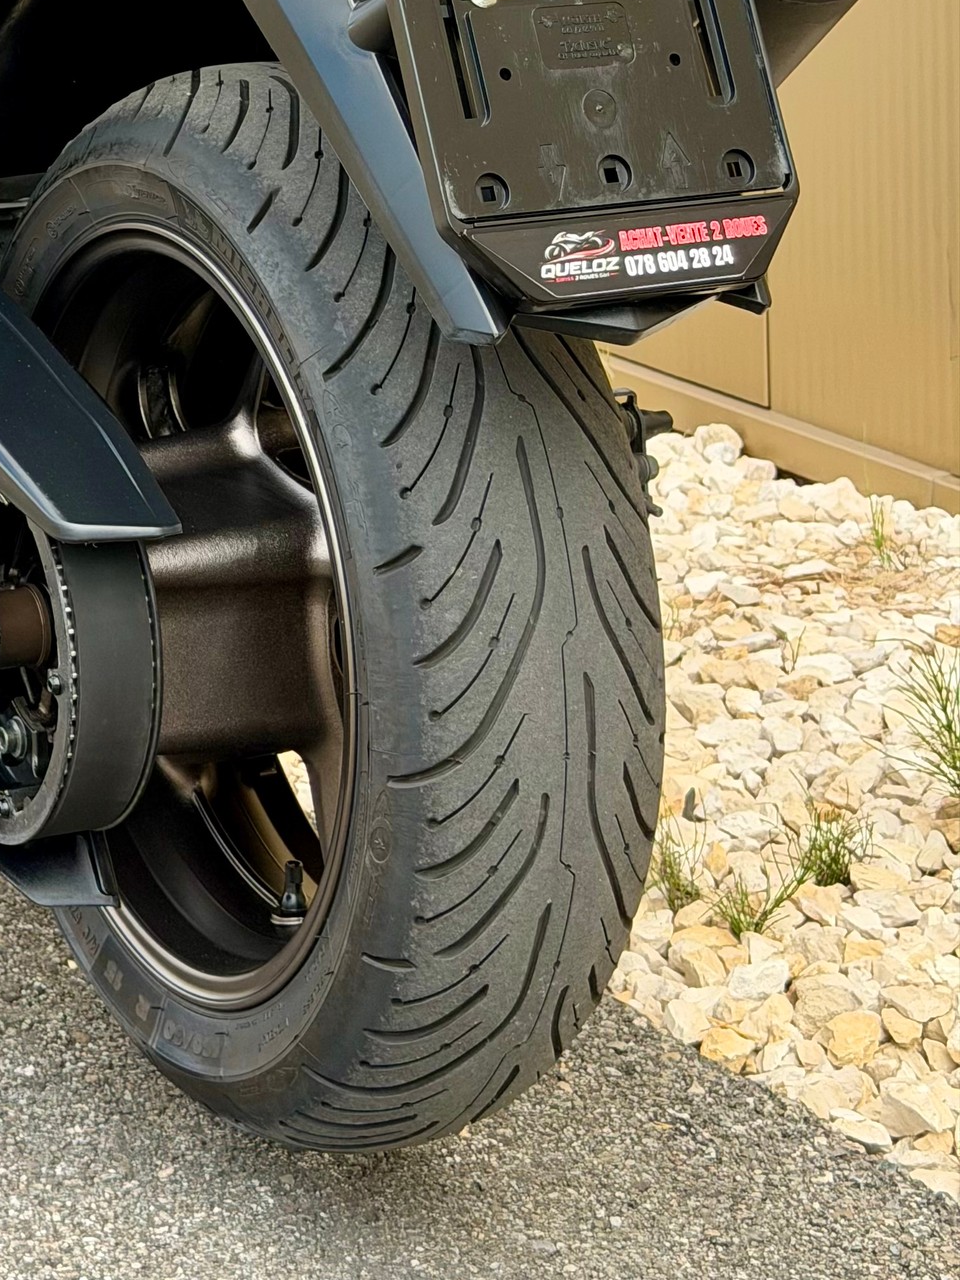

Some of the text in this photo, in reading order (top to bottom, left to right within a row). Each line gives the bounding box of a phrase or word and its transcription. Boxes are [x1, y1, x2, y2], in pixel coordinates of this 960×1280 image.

[618, 215, 768, 252] ACHAT-VENTE 2 ROUES
[541, 256, 620, 279] QUELOZ
[624, 244, 734, 277] 078 604 28 24
